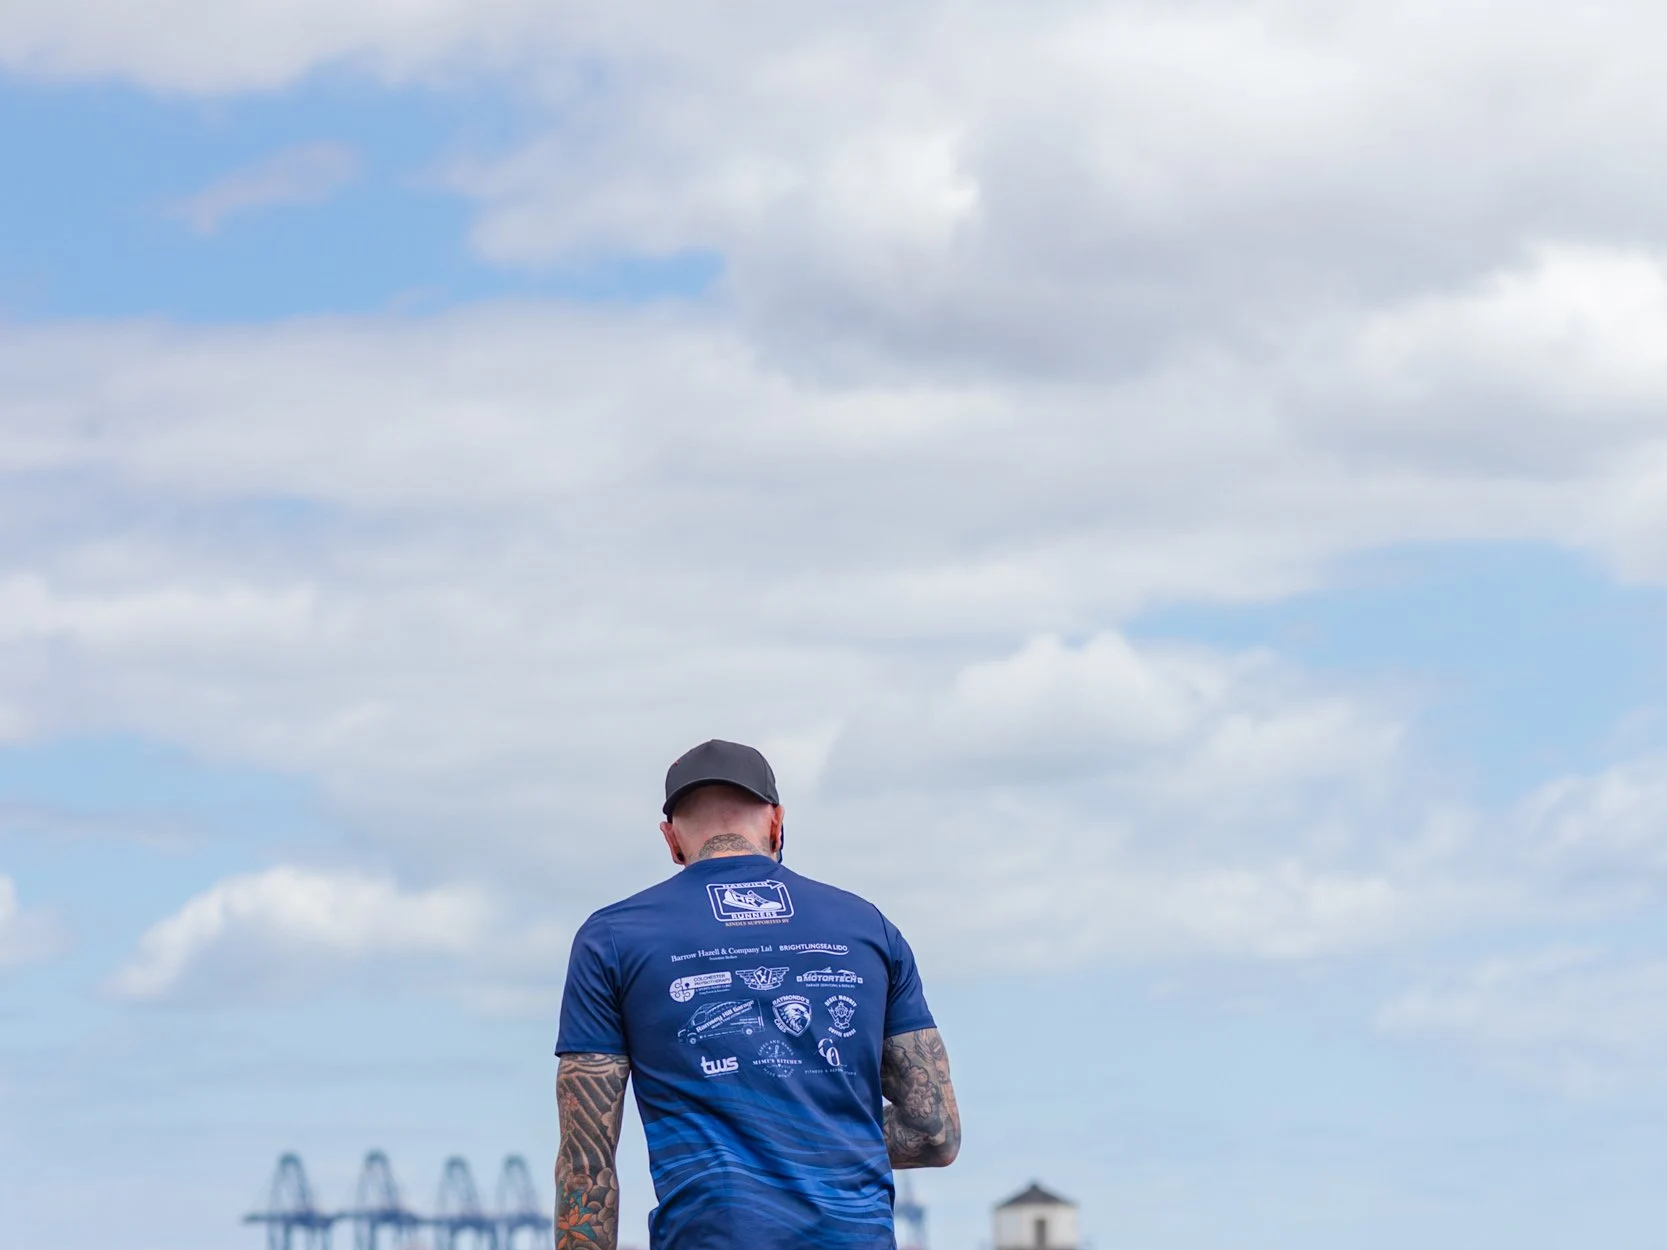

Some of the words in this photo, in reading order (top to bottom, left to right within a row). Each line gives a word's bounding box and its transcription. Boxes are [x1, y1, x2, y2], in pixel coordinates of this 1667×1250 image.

[671, 952, 697, 963] Barrow
[697, 948, 720, 957] Hazell
[728, 946, 760, 955] Company
[760, 944, 773, 953] Ltd
[779, 943, 833, 951] BRIGHTLINGSEA
[803, 975, 857, 983] MOTORTECH
[701, 1055, 739, 1074] tws
